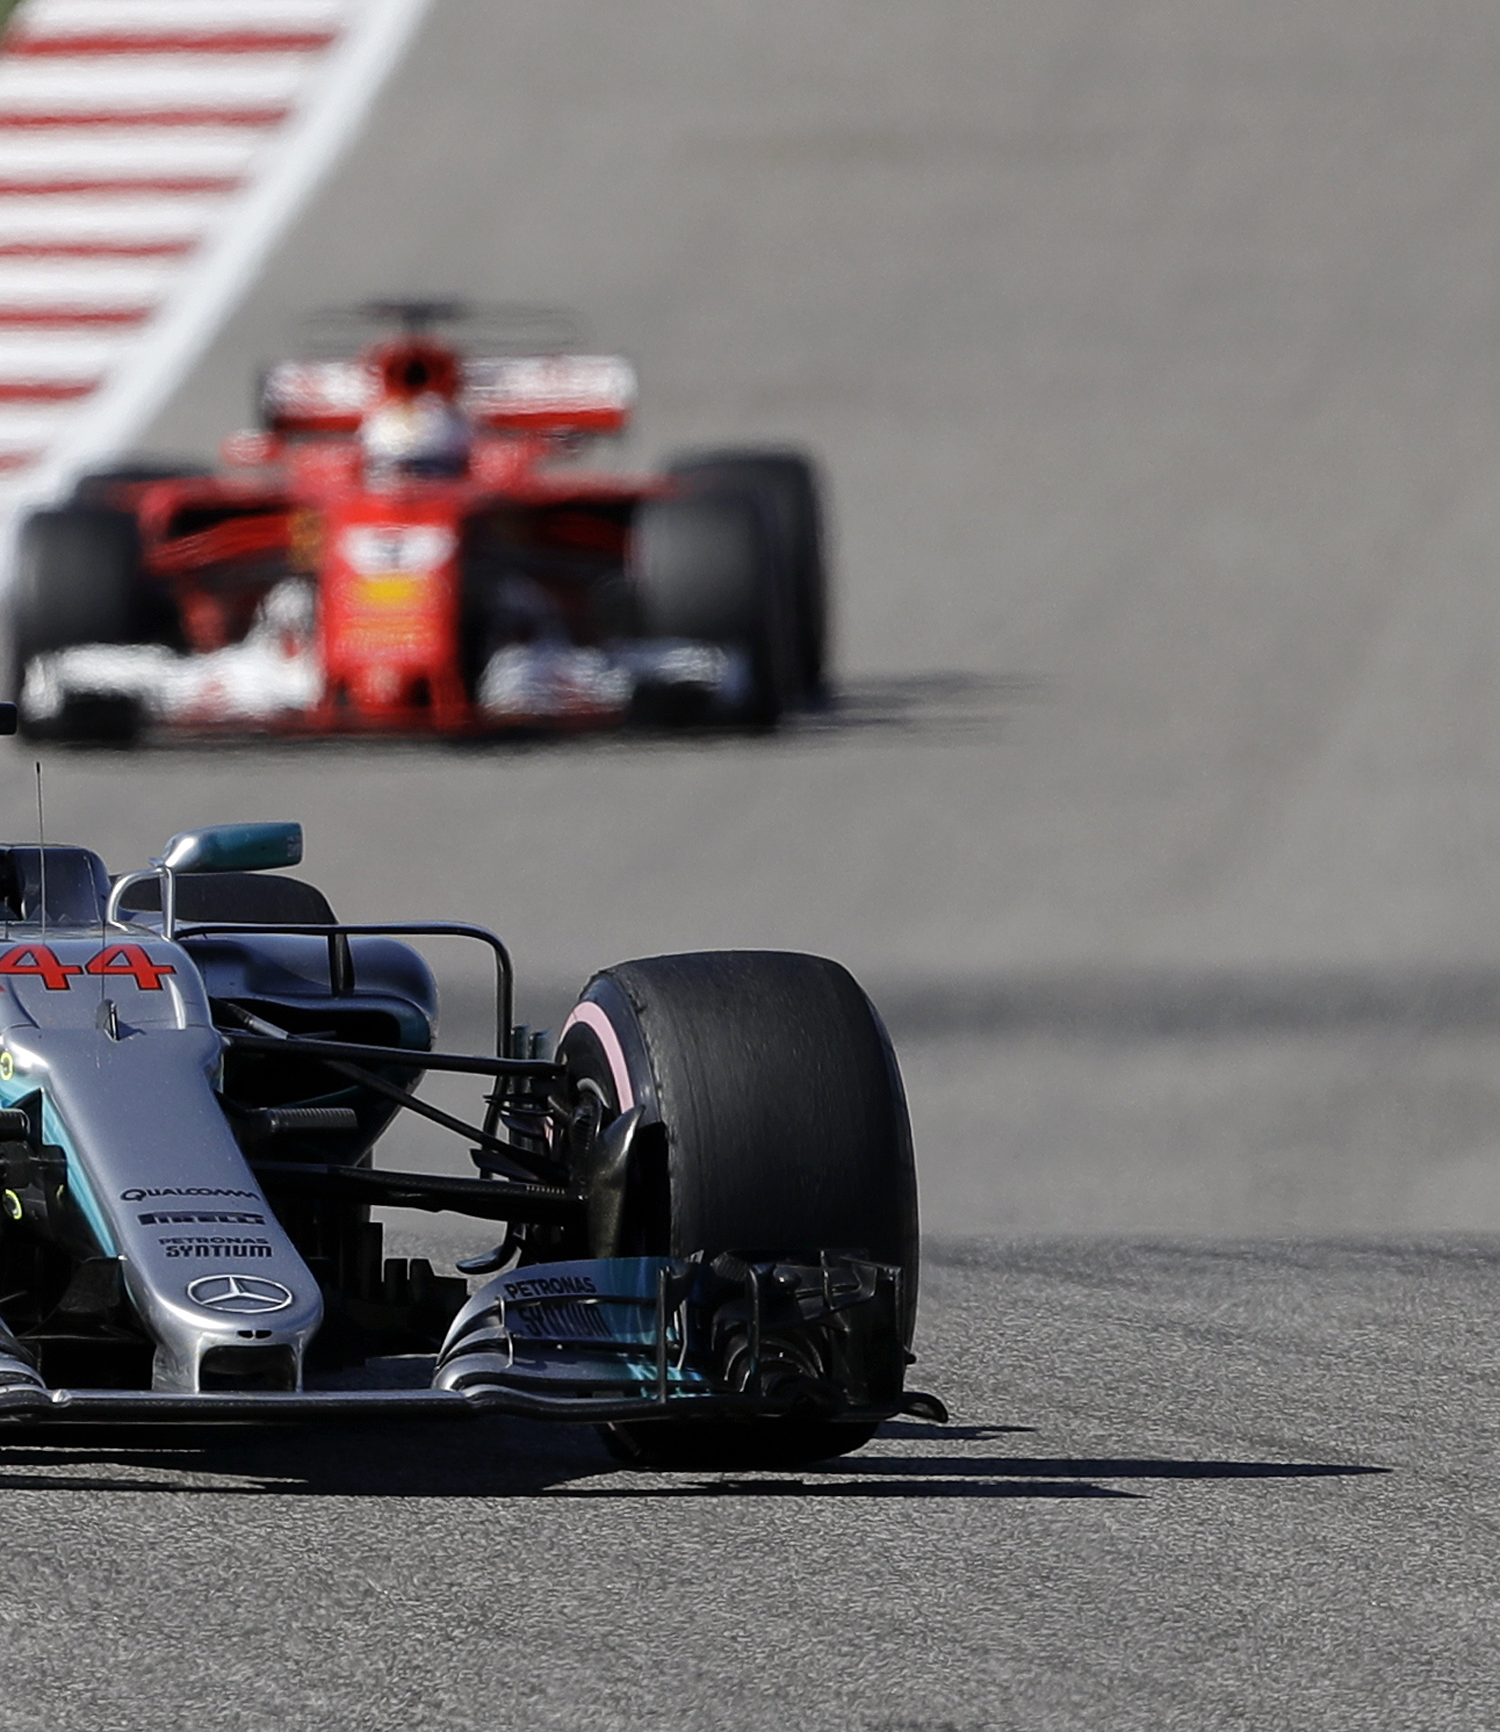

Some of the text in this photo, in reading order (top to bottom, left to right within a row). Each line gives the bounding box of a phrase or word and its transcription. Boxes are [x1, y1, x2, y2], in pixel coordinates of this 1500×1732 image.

[120, 1187, 261, 1202] QUALCOMM
[158, 1236, 269, 1245] PETRONAS
[166, 1245, 273, 1258] SYNTIUM
[503, 1276, 597, 1299] PETRONAS
